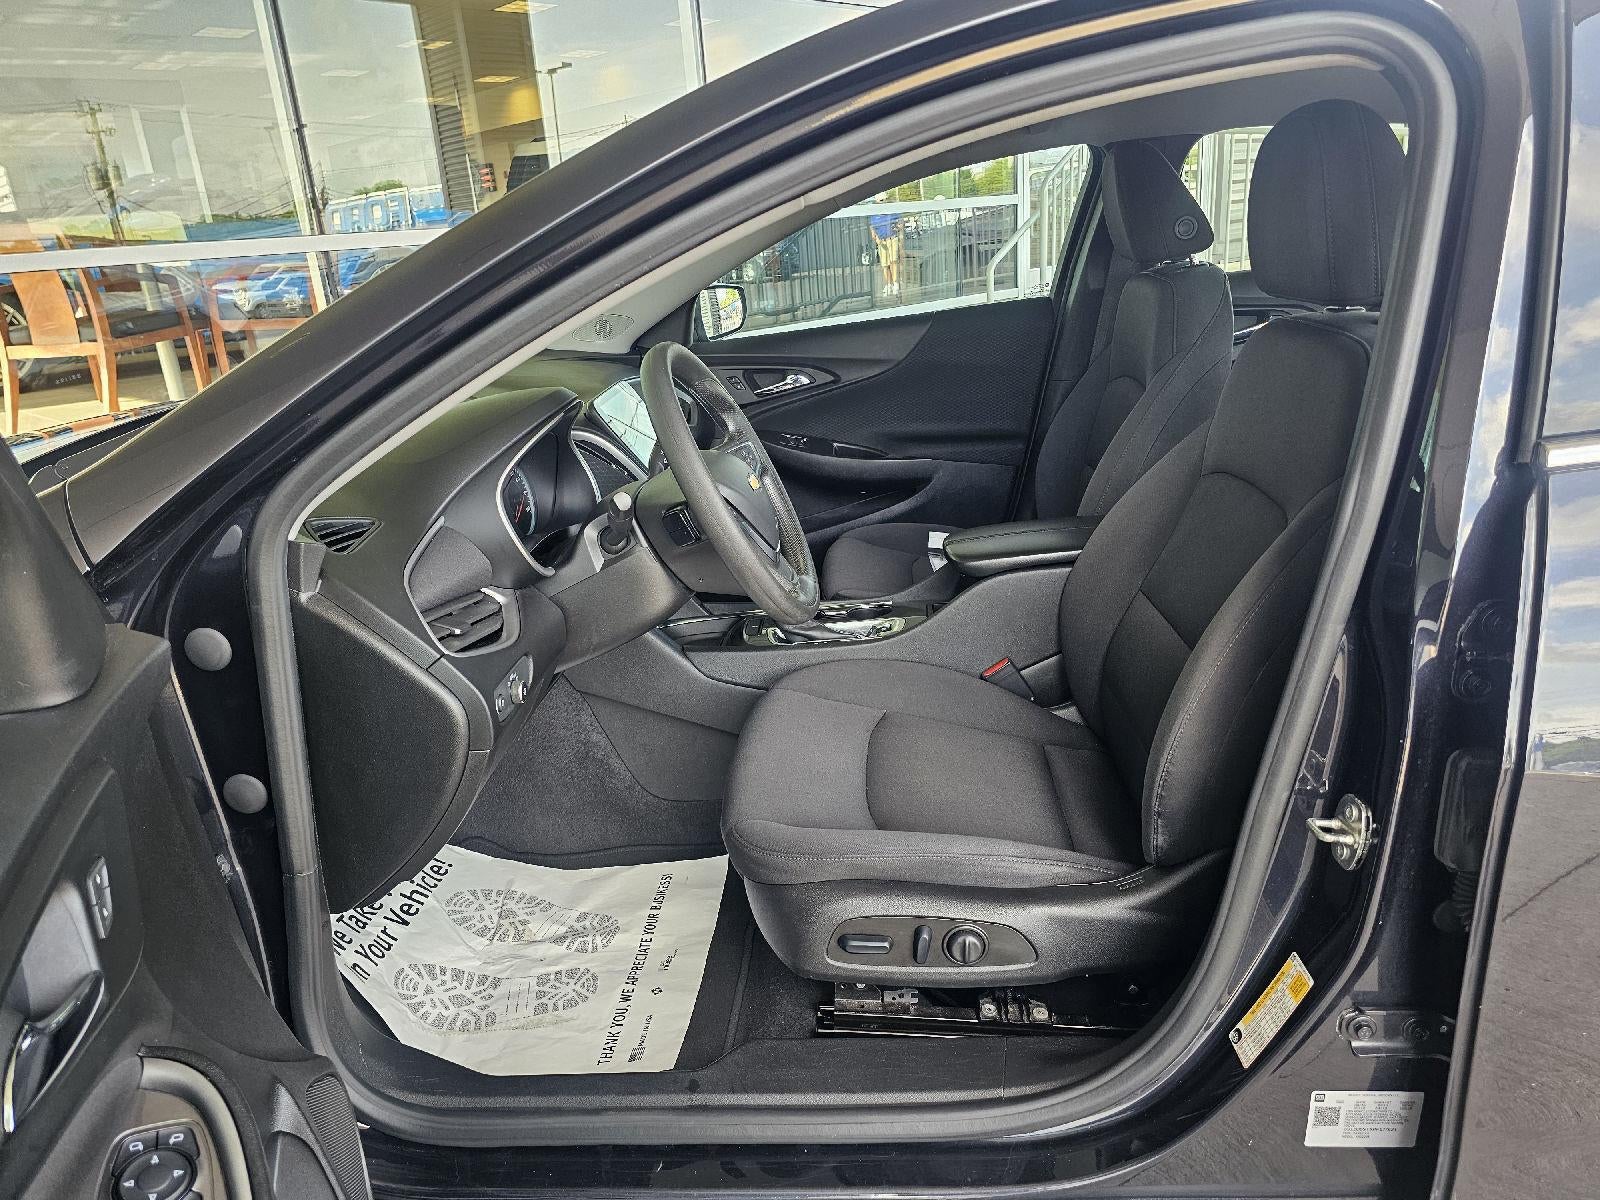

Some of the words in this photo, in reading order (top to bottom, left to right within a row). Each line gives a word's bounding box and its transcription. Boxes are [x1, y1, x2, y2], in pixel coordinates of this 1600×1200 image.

[354, 926, 399, 967] Your
[383, 858, 453, 926] Vehicle!
[642, 913, 660, 935] YOUR
[625, 937, 652, 986] APPRECIATE
[619, 988, 634, 1003] WE
[610, 1004, 631, 1028] YOU,
[597, 1031, 621, 1065] THANK
